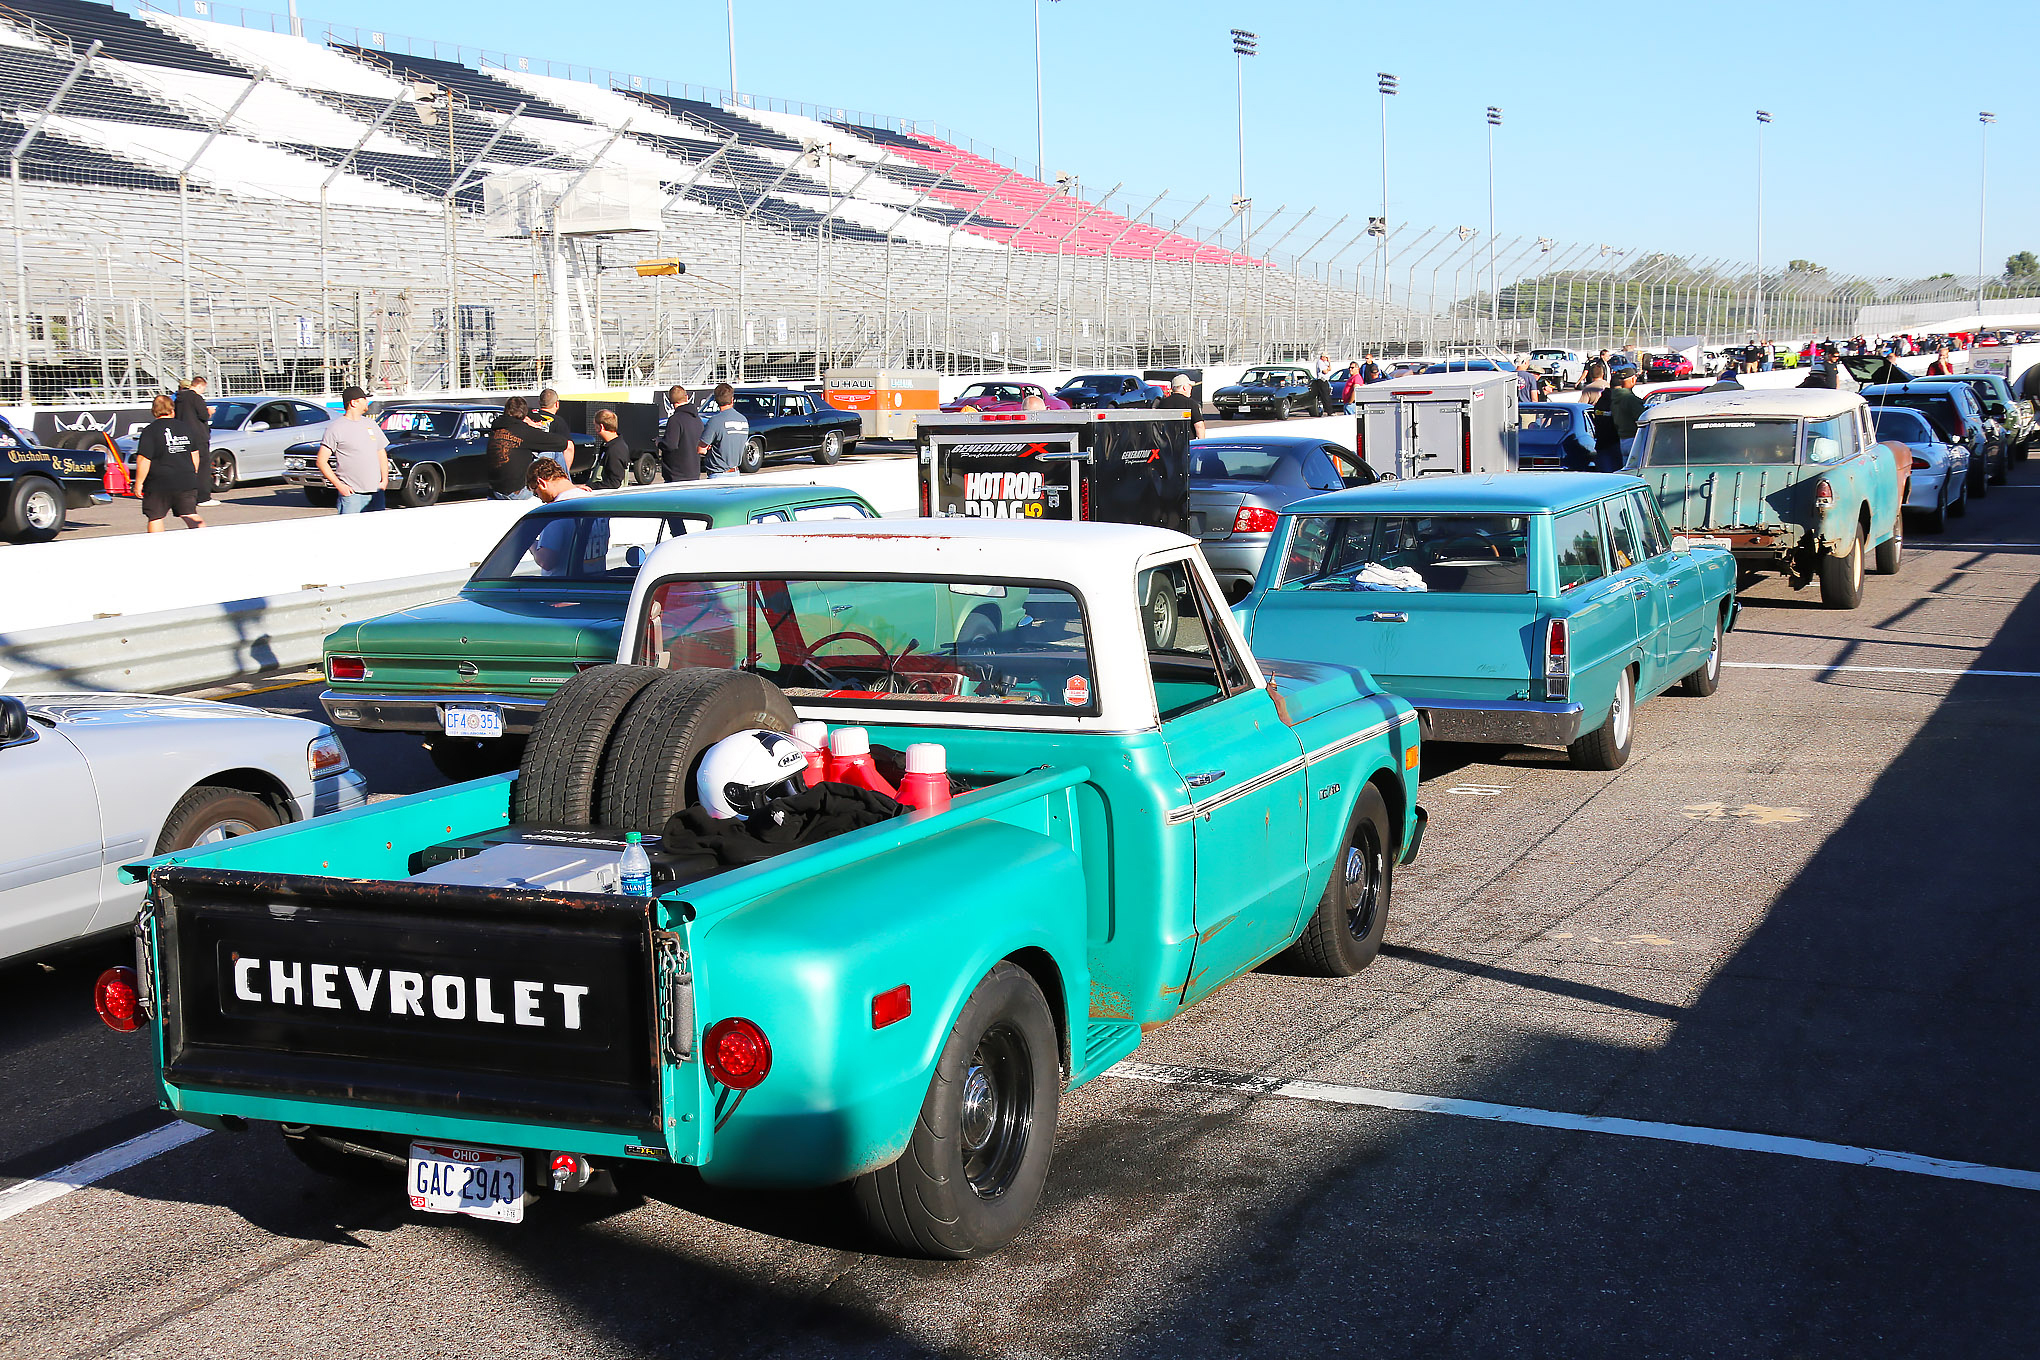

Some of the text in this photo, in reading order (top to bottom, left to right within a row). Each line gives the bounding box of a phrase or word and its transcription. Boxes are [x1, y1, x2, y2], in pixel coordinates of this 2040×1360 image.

[195, 1, 207, 14] 37
[830, 380, 874, 389] U-HAUL
[951, 442, 1049, 458] GENERATION X
[964, 471, 1045, 500] HOT ROD
[447, 713, 500, 730] CF4 351
[234, 957, 590, 1031] CHEVROLET
[452, 1149, 481, 1162] OHIO
[417, 1161, 515, 1205] GAC 2943
[411, 1196, 426, 1207] 25
